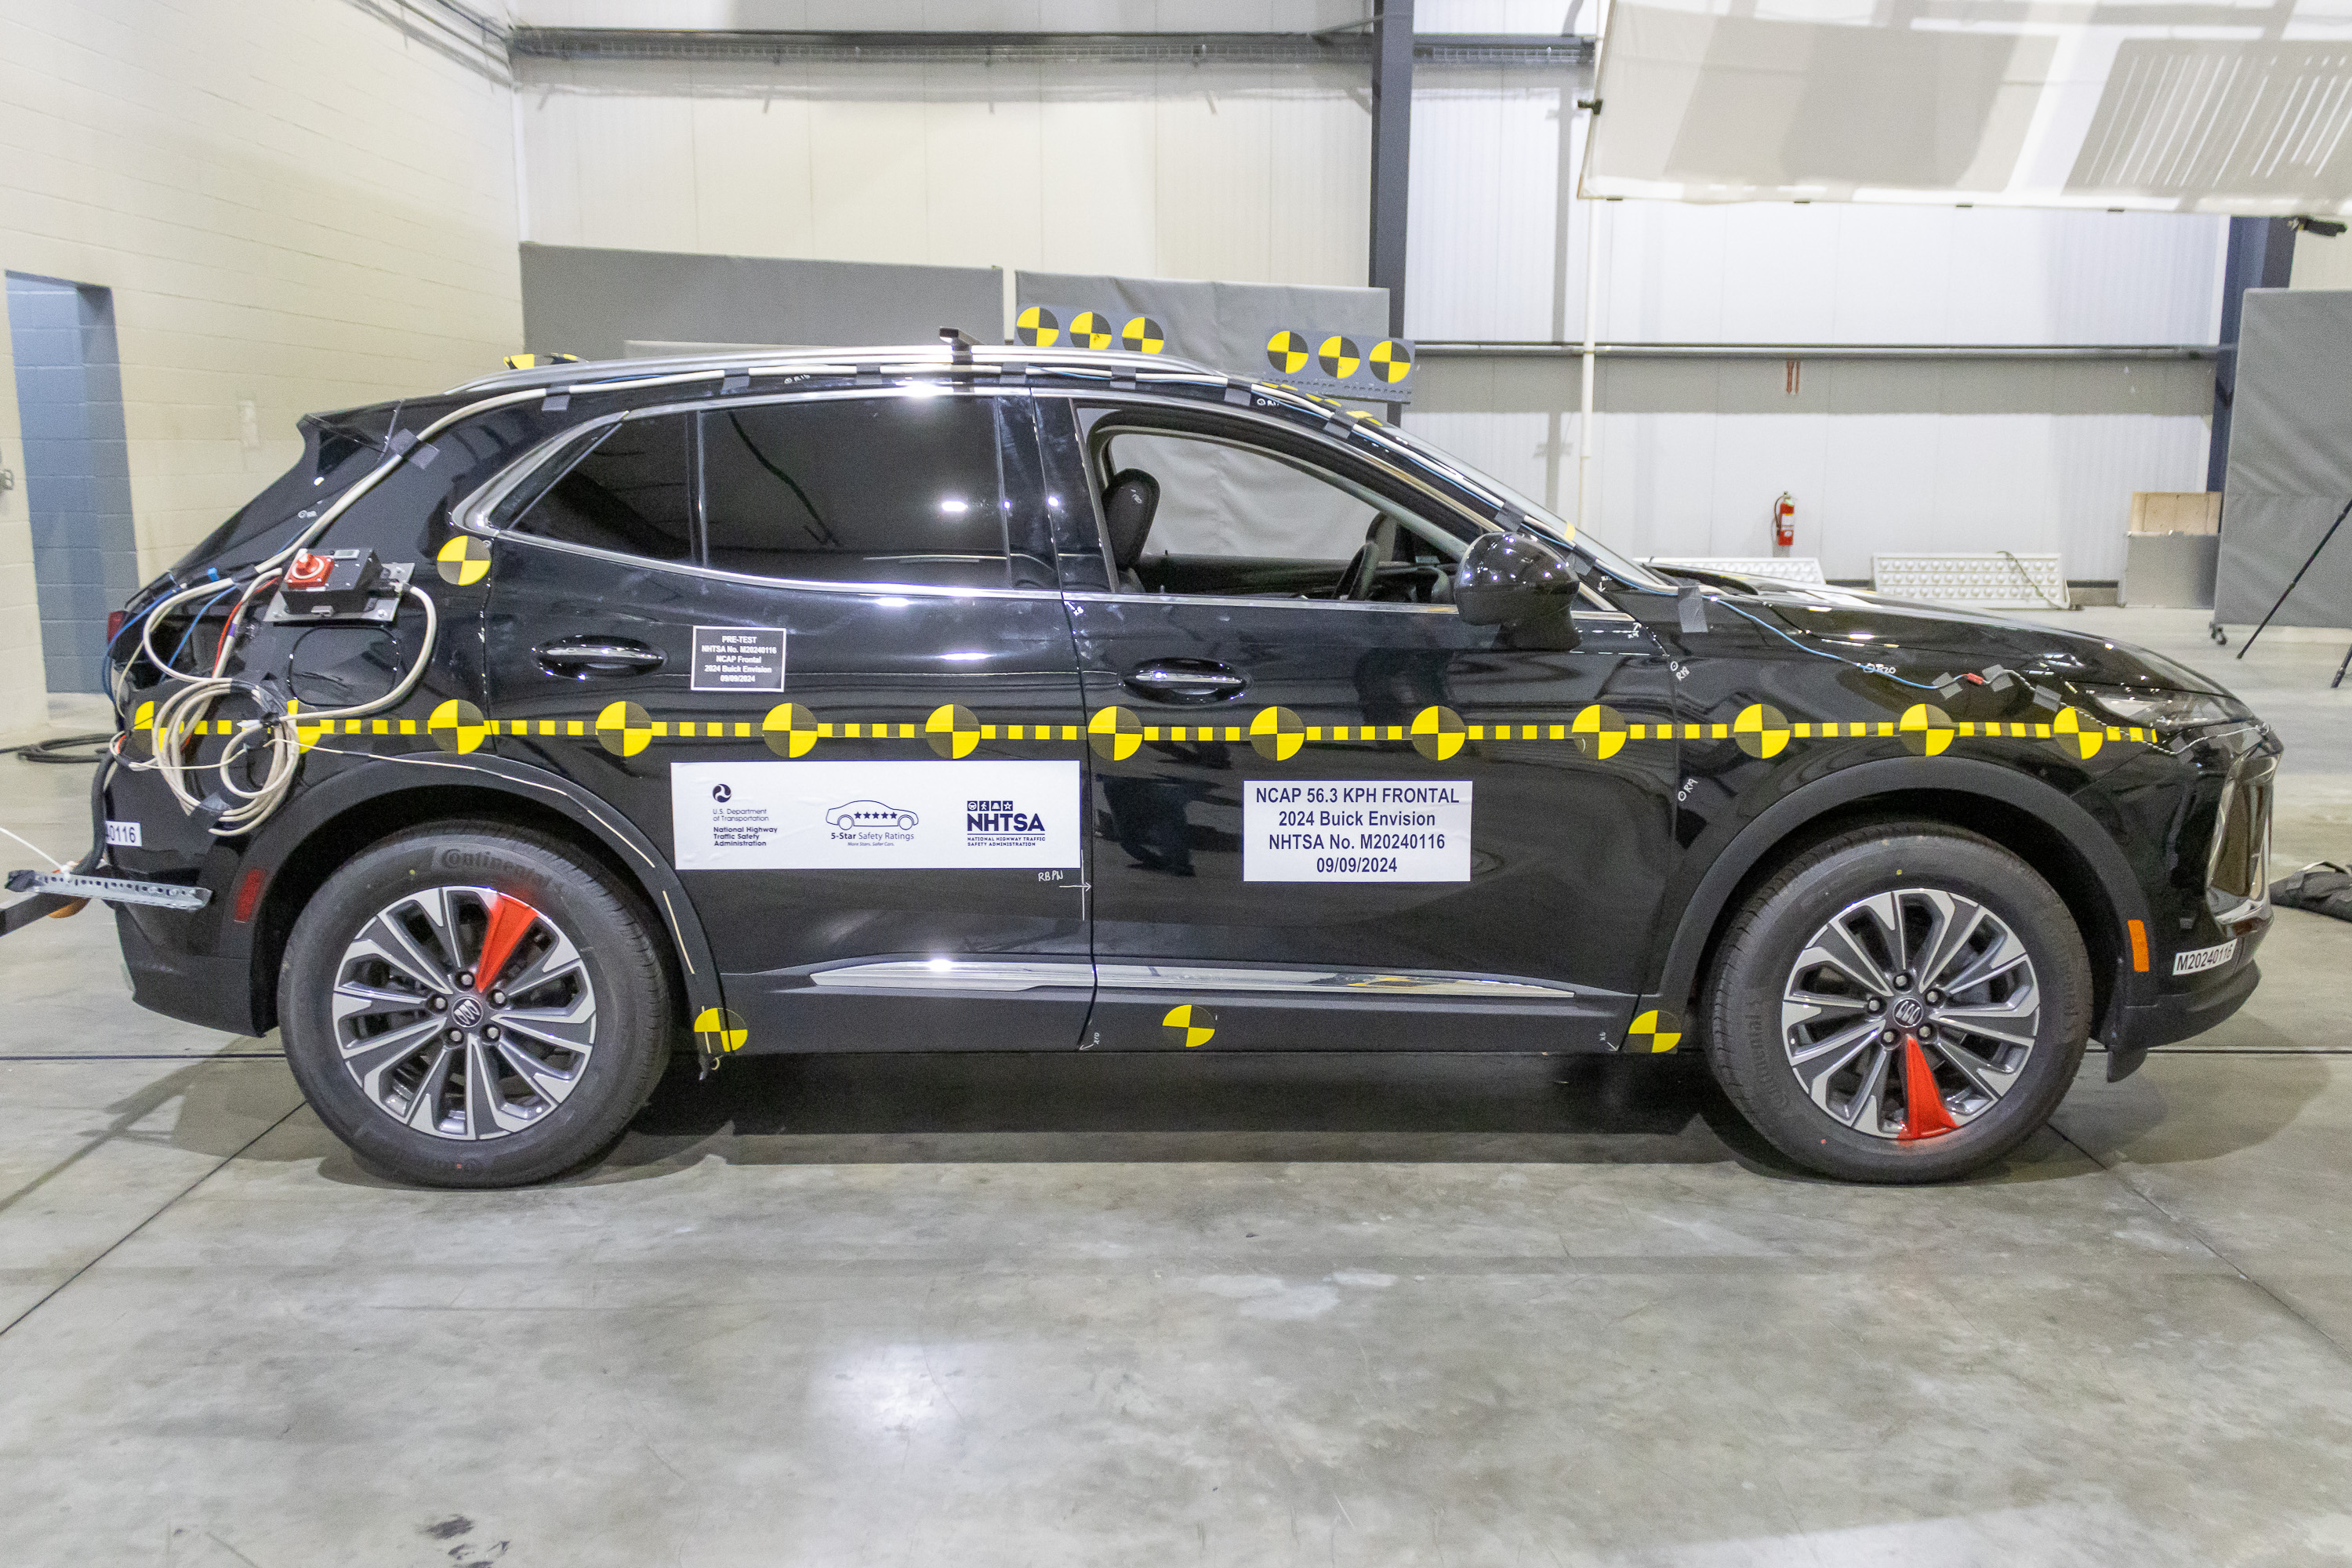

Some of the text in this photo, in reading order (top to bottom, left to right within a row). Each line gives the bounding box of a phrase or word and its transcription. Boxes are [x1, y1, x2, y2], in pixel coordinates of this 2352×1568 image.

[721, 635, 757, 644] PRE-TEST
[739, 646, 777, 655] M20240116
[737, 655, 762, 664] Frontal
[720, 674, 756, 683] 09/09/2024
[1256, 787, 1460, 804] NCAP 56.3 KPH FRONTAL
[967, 813, 1046, 832] NHTSA
[1279, 811, 1436, 826] 2024 Buick Envision
[107, 825, 136, 843] 0116
[858, 832, 883, 841] Safety
[884, 832, 914, 841] Ratings
[1269, 833, 1446, 850] NHTSA No. M20240116
[1316, 857, 1398, 873] 09/09/2024
[2176, 943, 2234, 971] M20240116
